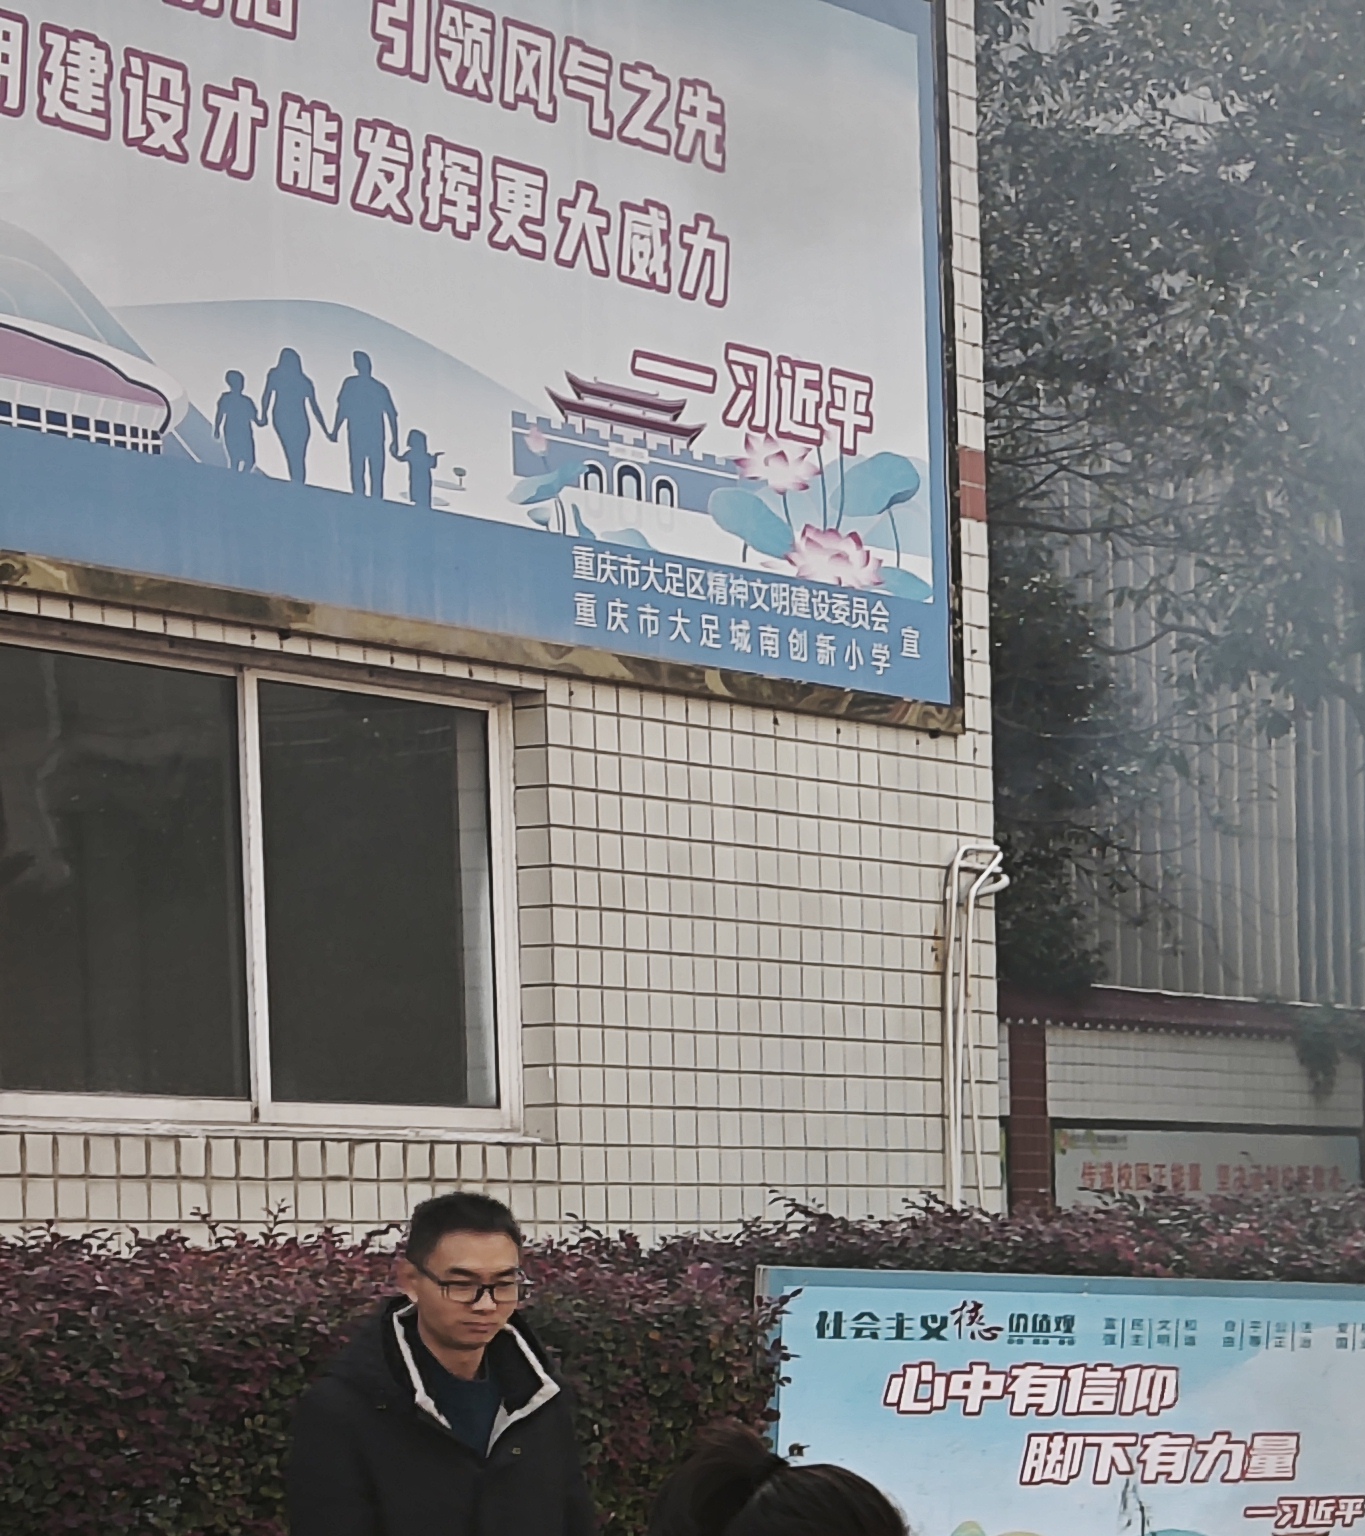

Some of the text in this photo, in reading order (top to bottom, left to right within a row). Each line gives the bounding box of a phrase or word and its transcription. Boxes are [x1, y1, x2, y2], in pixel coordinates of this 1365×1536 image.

[371, 0, 726, 173] 引领风气之先
[572, 545, 890, 634] 重庆市大足区精神文明建设委员会
[573, 592, 891, 676] 重庆市大足城南创新小学
[901, 626, 922, 660] 宣
[883, 1361, 1179, 1416] 心中有信仰
[1019, 1431, 1301, 1486] 脚下有力量
